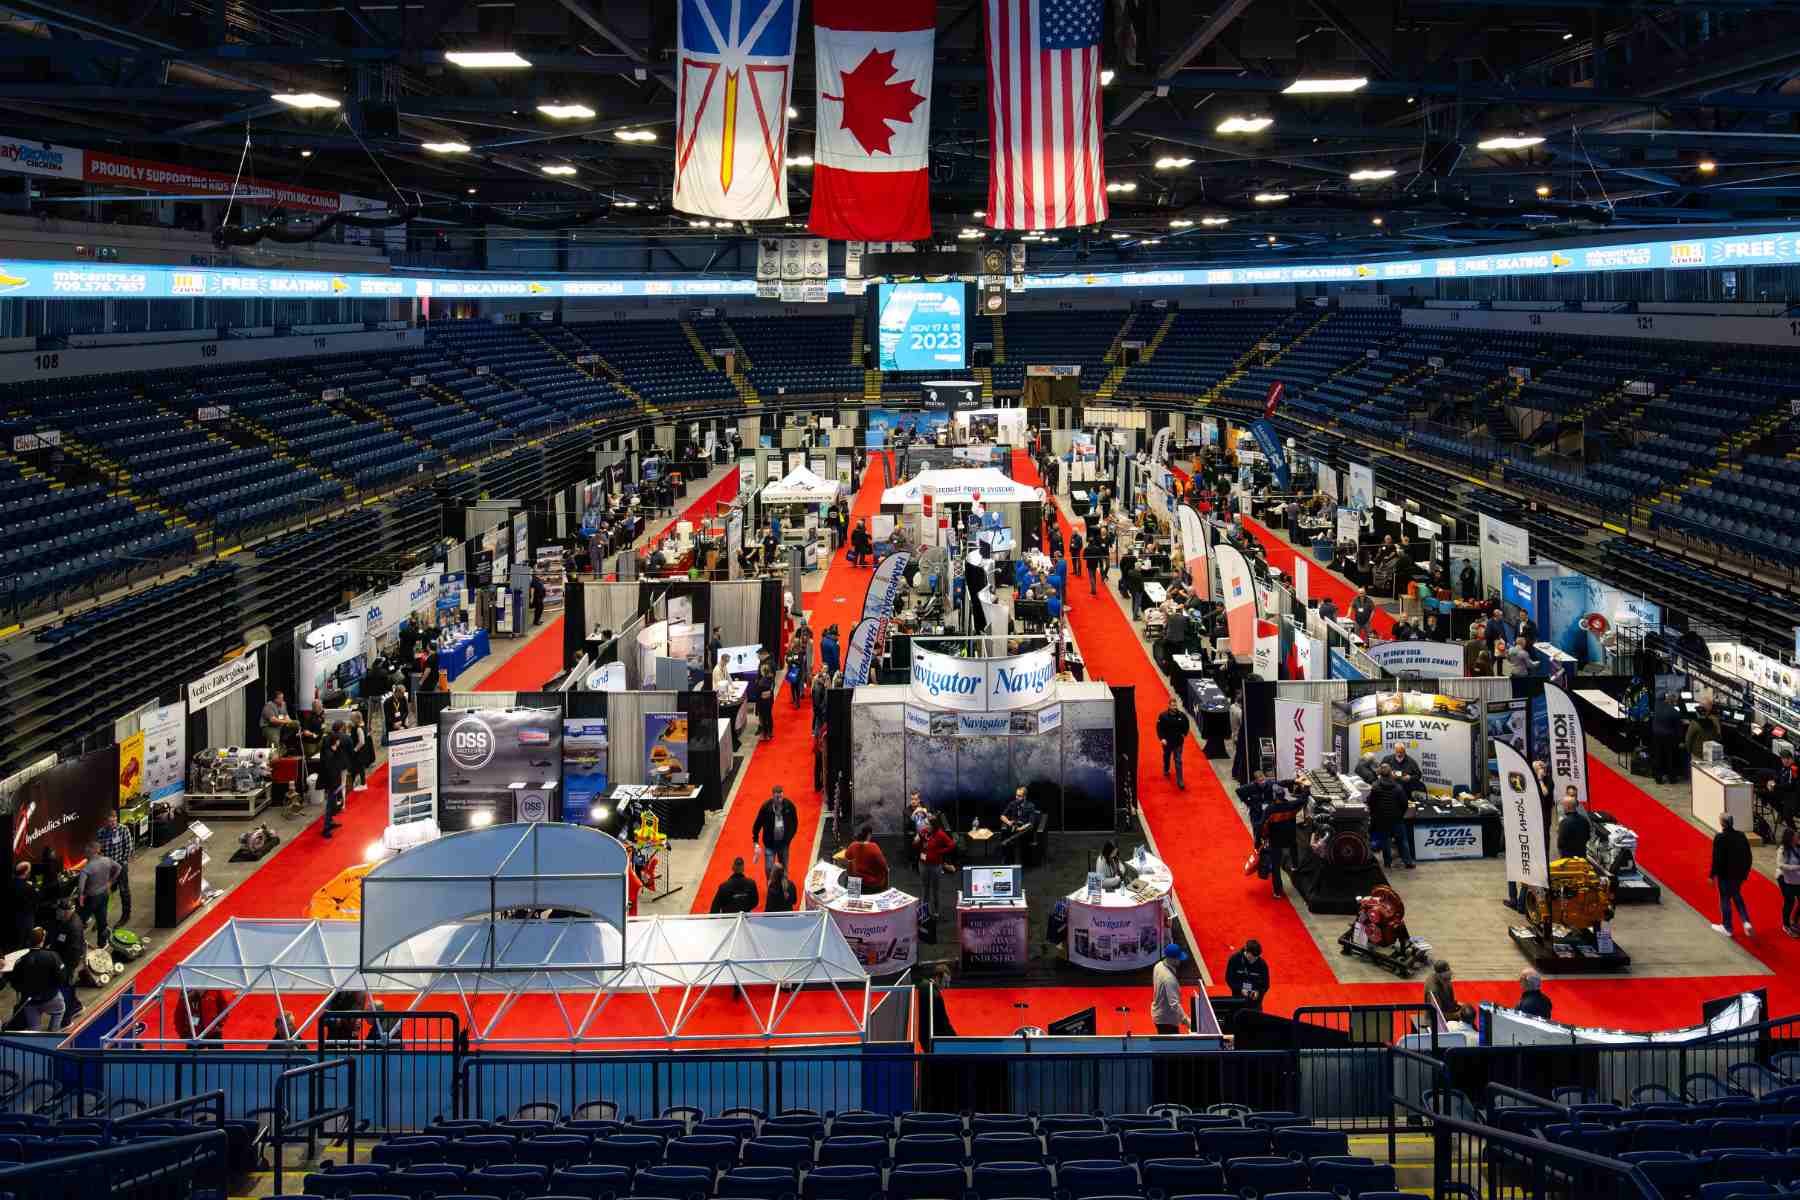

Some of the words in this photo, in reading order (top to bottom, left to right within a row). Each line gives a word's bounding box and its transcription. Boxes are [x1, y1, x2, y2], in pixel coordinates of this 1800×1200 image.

[91, 160, 144, 181] PROUDLY
[146, 168, 207, 189] SUPPORTING
[1725, 240, 1775, 257] FREE
[1495, 255, 1548, 268] SKATING
[221, 276, 258, 289] FREE
[269, 278, 329, 291] SKATING
[462, 283, 525, 294] SKATING
[910, 324, 928, 332] NOV
[1638, 316, 1653, 329] 121
[911, 333, 961, 349] 2023
[201, 345, 217, 357] 109
[36, 354, 59, 370] 108
[192, 683, 211, 698] Active
[960, 715, 1009, 731] Navigator
[1386, 720, 1415, 729] NEW
[1419, 720, 1450, 732] WAY
[456, 732, 487, 748] DSS
[1386, 731, 1432, 741] DIESEL
[525, 801, 541, 811] DSS
[25, 819, 61, 846] hydraulics
[63, 811, 80, 824] inc.
[1429, 828, 1472, 838] TOTAL
[1424, 837, 1477, 847] POWER
[848, 924, 888, 937] Navigator
